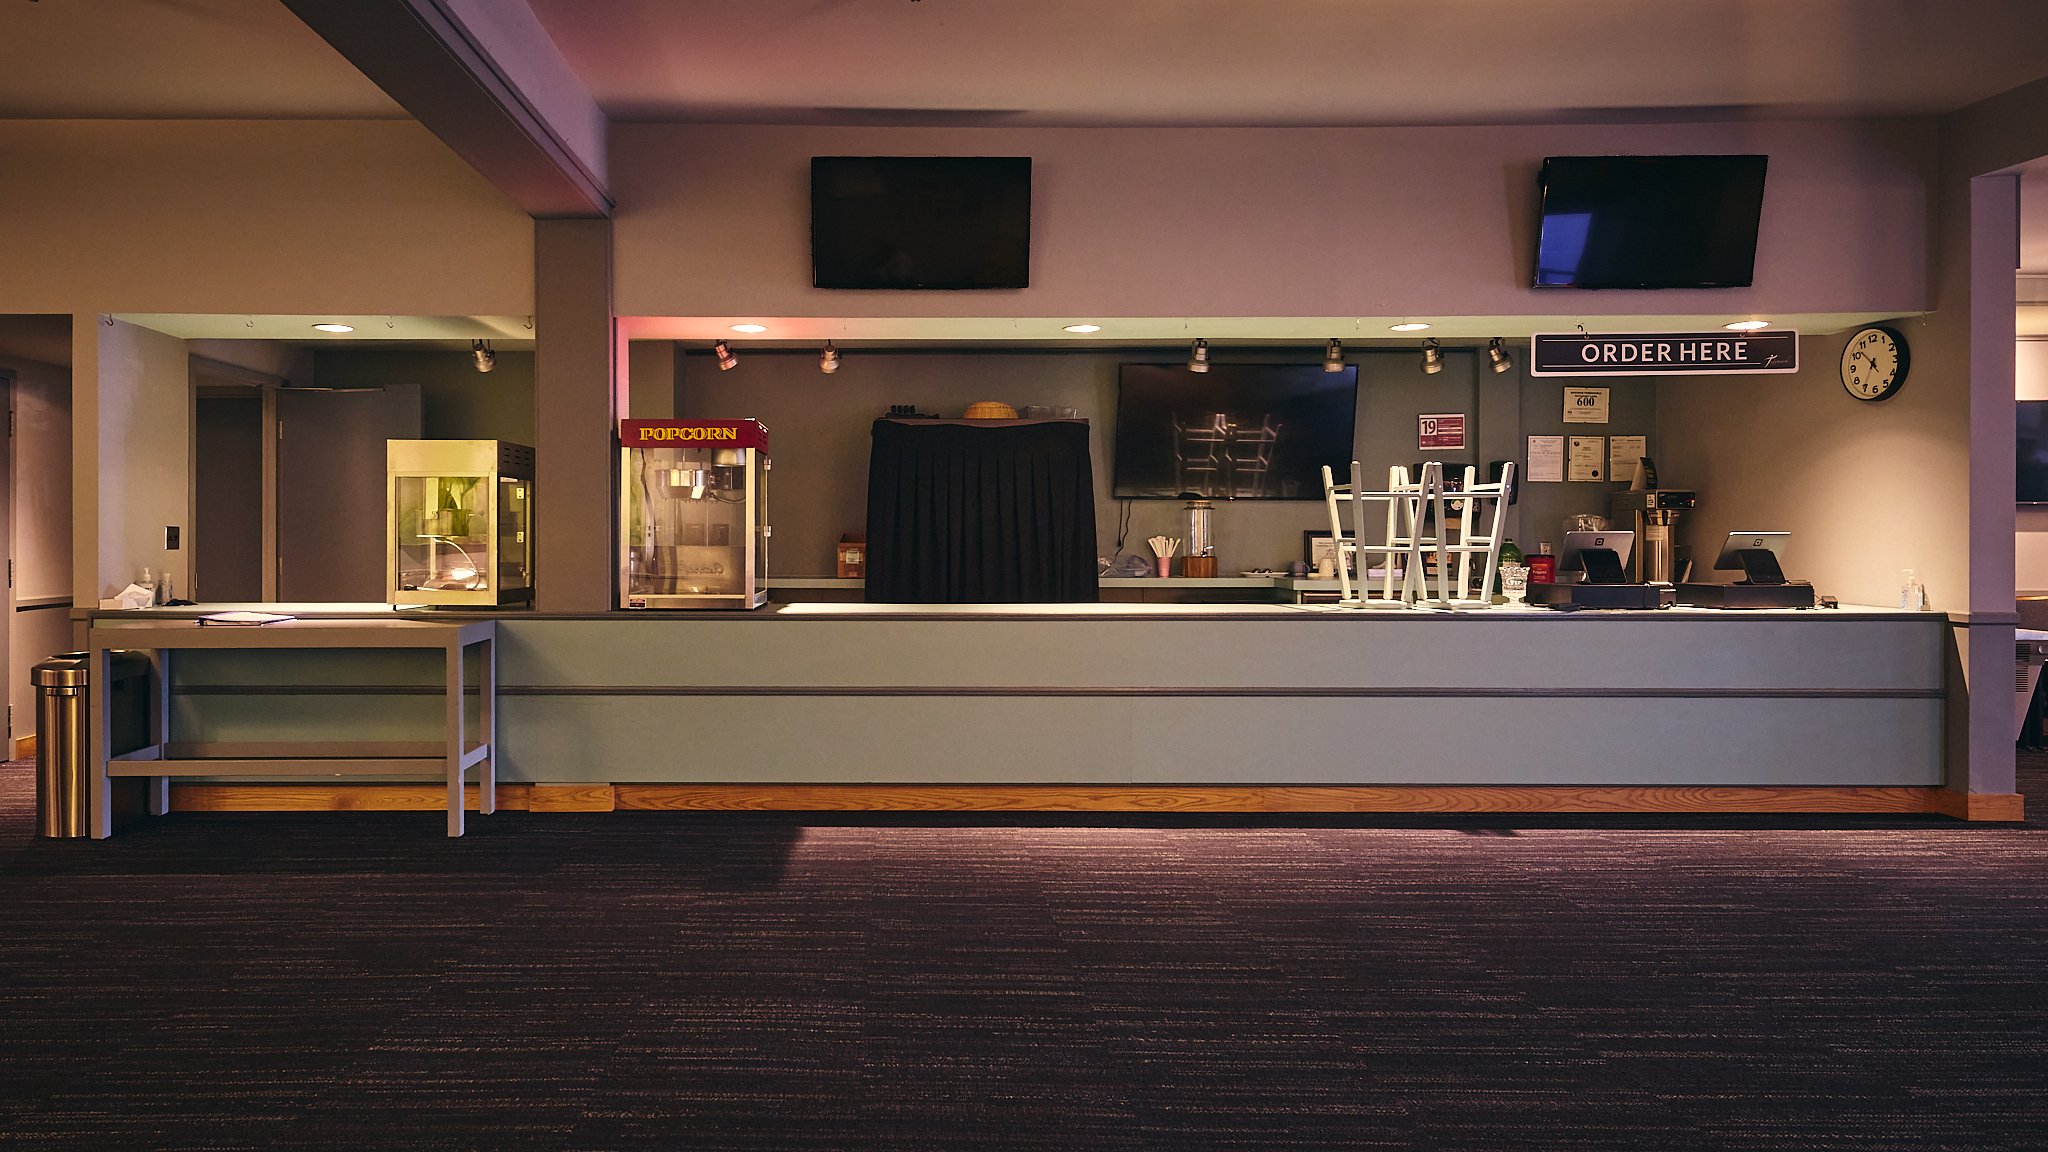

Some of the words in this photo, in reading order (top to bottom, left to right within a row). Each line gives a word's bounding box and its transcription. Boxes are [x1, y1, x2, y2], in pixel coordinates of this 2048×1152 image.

[1868, 334, 1877, 343] 12
[1882, 336, 1886, 344] 1
[1860, 340, 1866, 350] 11
[1888, 343, 1895, 352] 2
[1581, 343, 1671, 363] ORDER
[1679, 341, 1748, 361] HERE
[1852, 352, 1861, 360] 10
[1892, 354, 1898, 363] 3
[1850, 365, 1856, 373] 9
[1854, 376, 1860, 384] 8
[1882, 379, 1888, 388] 5
[1862, 384, 1868, 392] 7
[1872, 385, 1878, 394] 6
[1576, 397, 1595, 406] 600
[1422, 420, 1436, 434] 19
[639, 427, 738, 441] POPCORN
